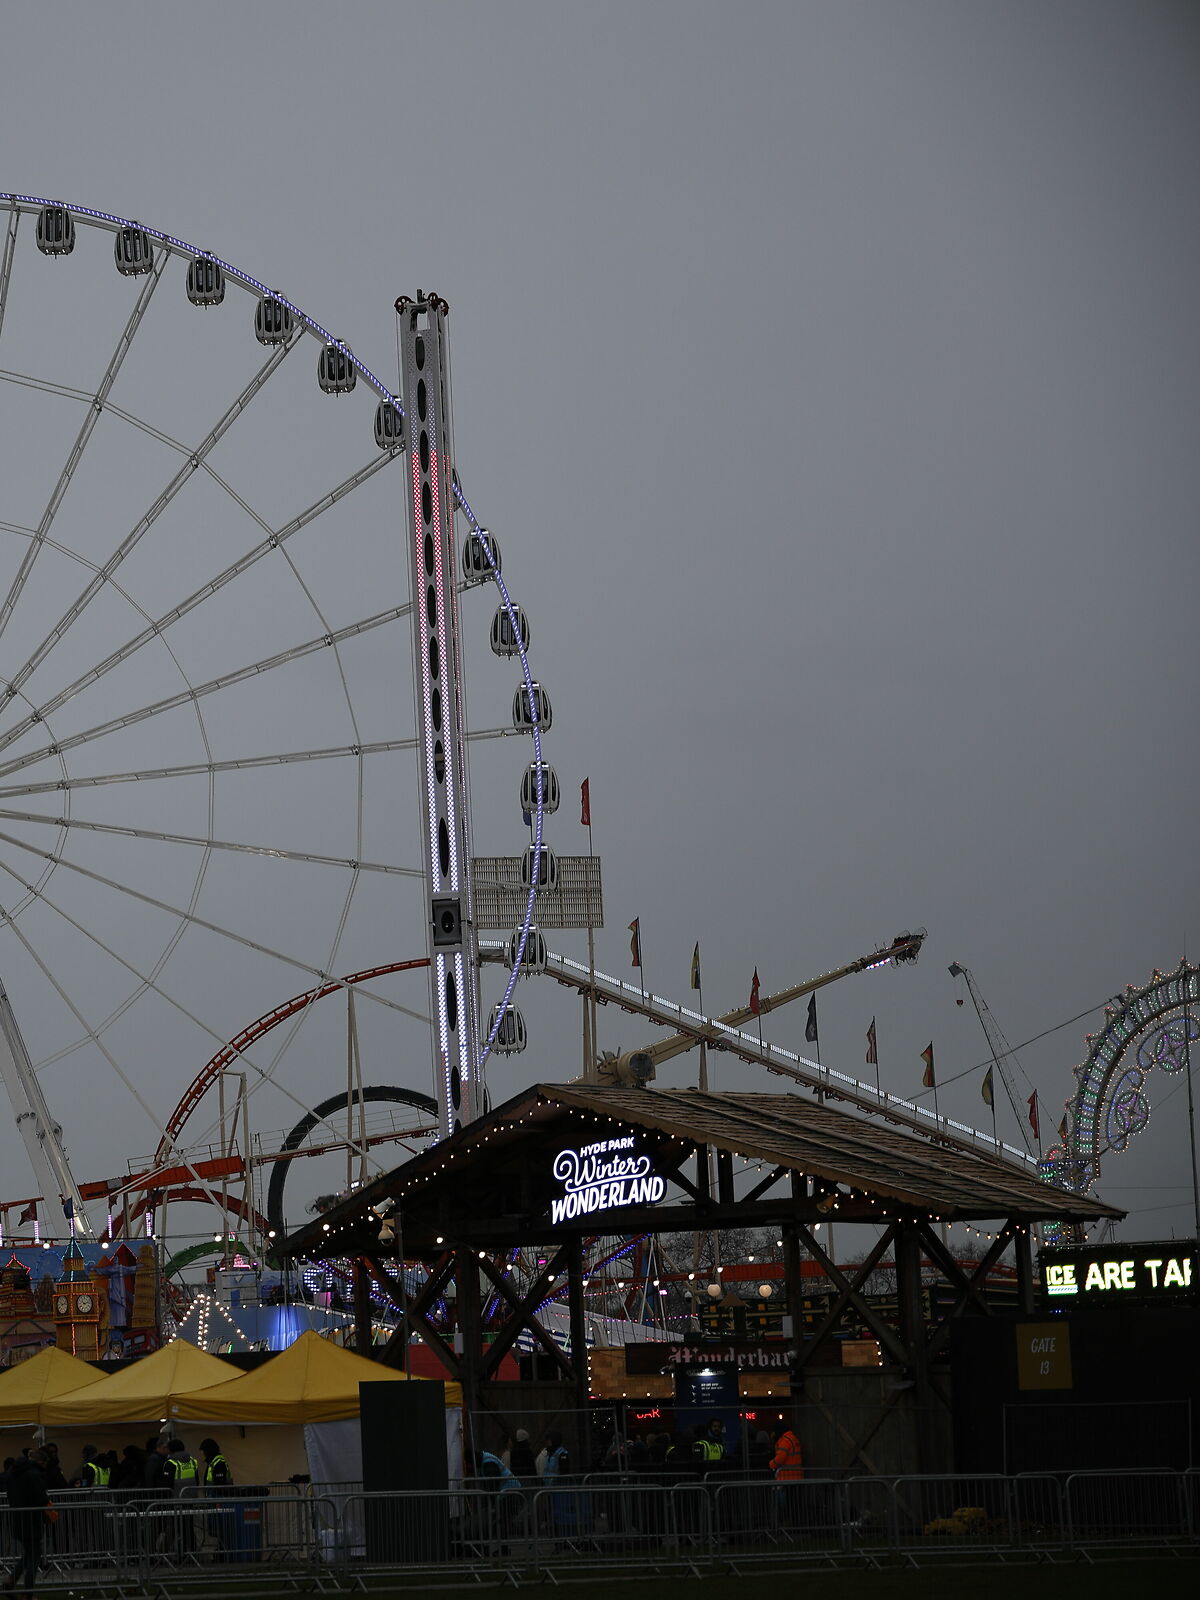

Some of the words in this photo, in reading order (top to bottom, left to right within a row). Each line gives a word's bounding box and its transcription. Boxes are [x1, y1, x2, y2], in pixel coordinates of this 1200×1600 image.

[580, 1141, 607, 1158] HYDE
[608, 1137, 634, 1151] PARK
[553, 1149, 650, 1192] Winter
[551, 1177, 664, 1224] WONDERLAND
[1085, 1260, 1136, 1291] ARE
[1031, 1337, 1056, 1353] GATE
[1040, 1361, 1051, 1375] 13
